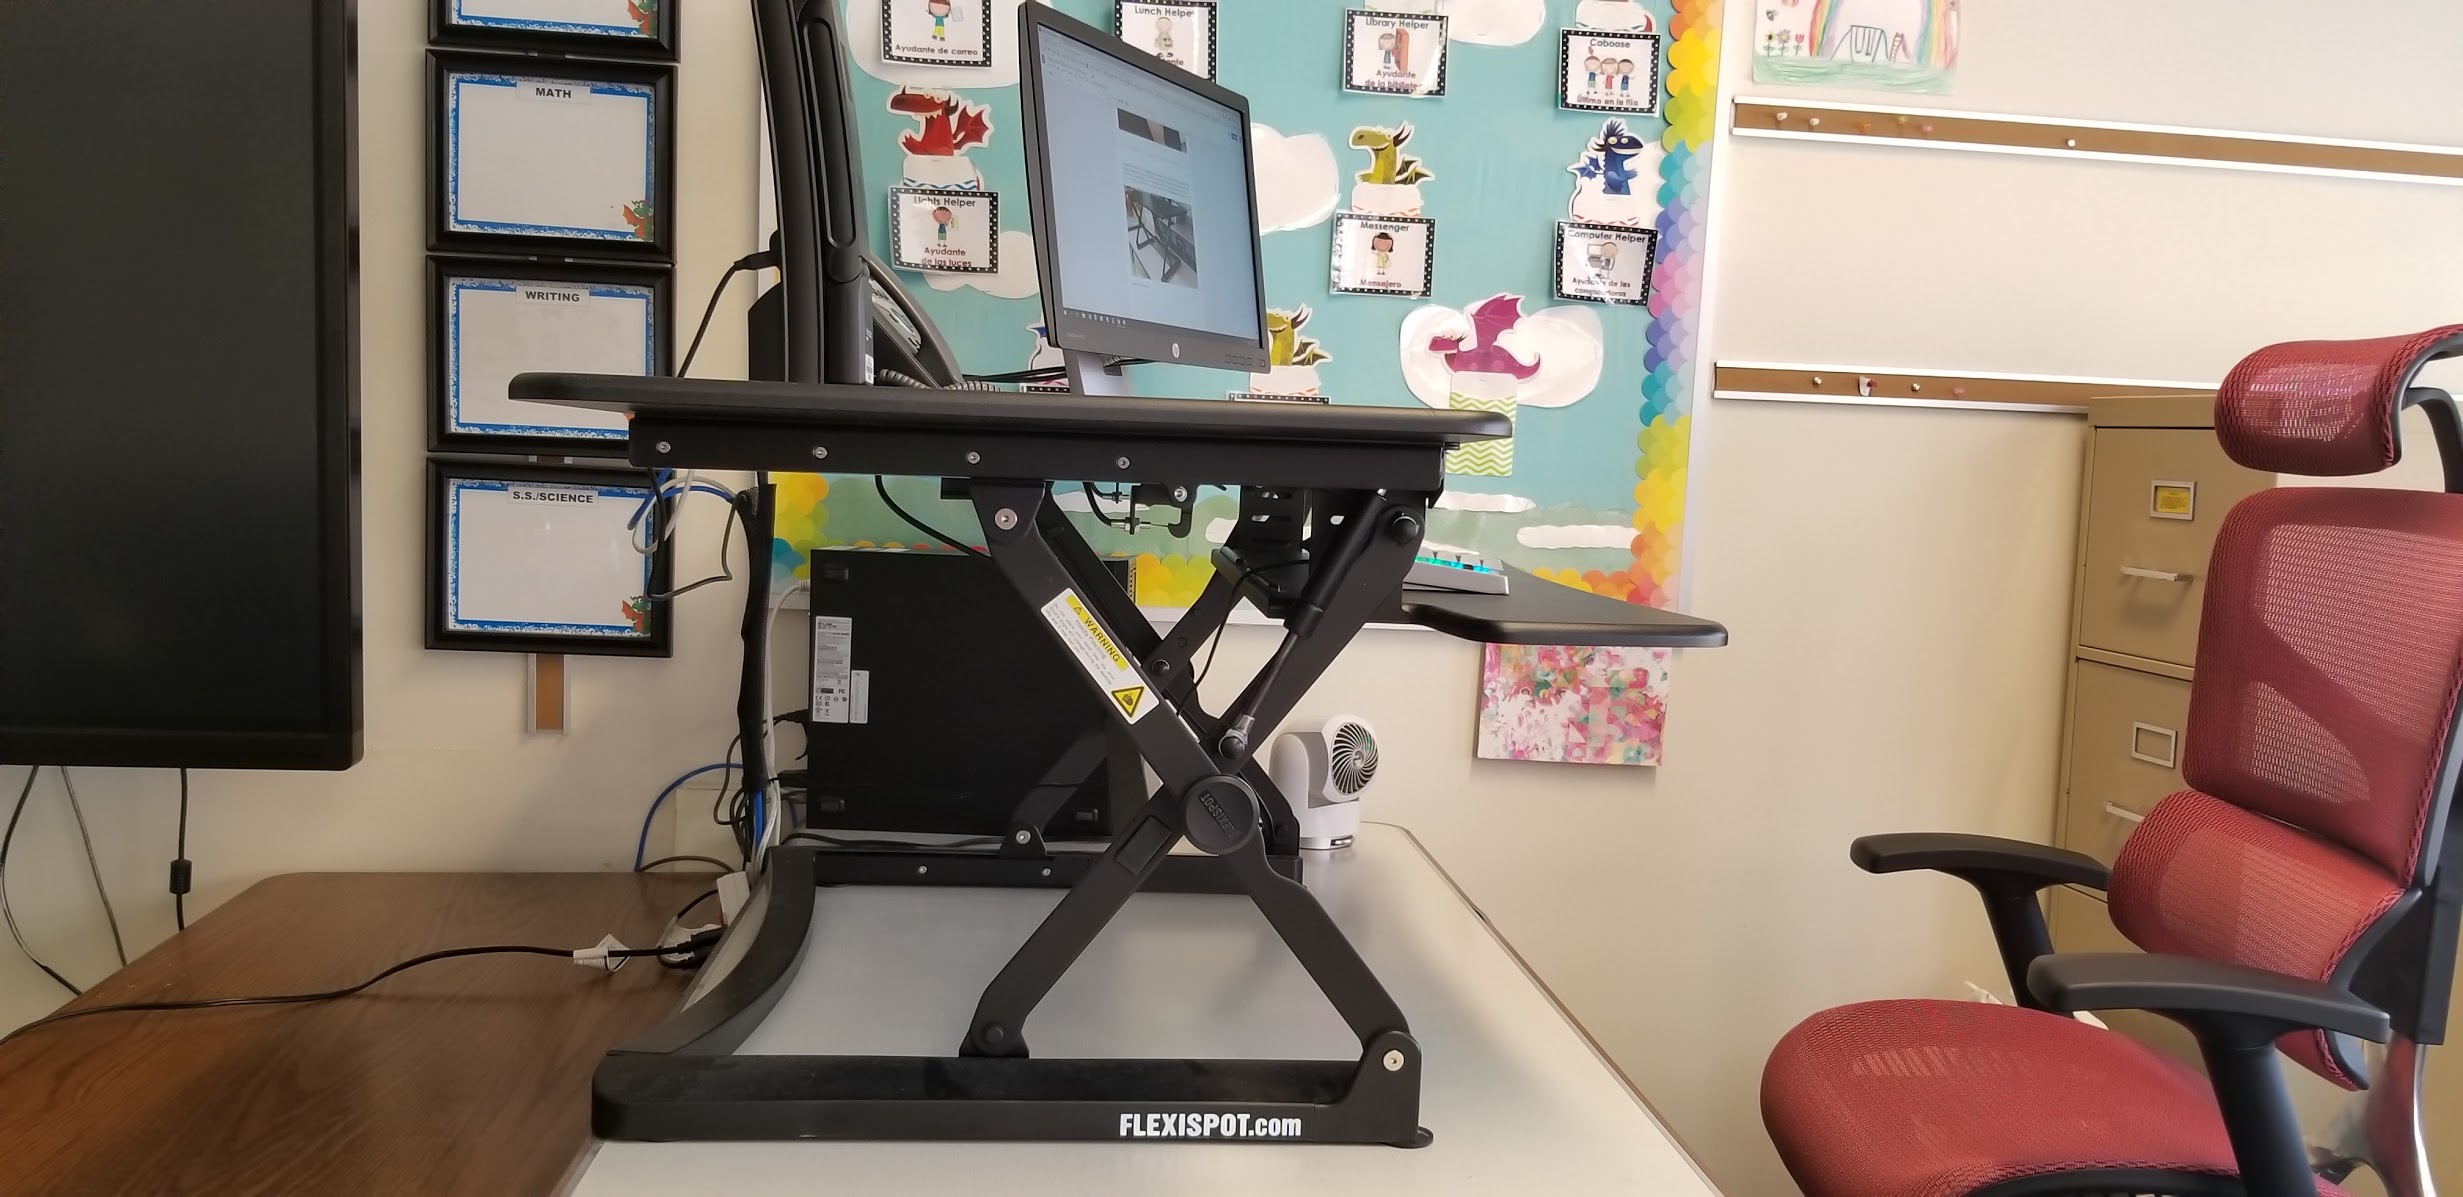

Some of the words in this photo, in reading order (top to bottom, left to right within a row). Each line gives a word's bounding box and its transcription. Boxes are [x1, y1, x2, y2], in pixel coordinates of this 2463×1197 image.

[1134, 5, 1162, 16] Lunch
[1365, 17, 1396, 29] Library
[1398, 19, 1429, 30] Helper
[1589, 38, 1631, 49] Caboose
[895, 44, 936, 54] Ayudante
[937, 47, 949, 55] de
[951, 48, 979, 56] correo
[1376, 69, 1416, 79] Ayudante
[535, 87, 572, 99] MATH
[943, 197, 975, 208] Helper
[1360, 221, 1410, 233] Messenger
[1567, 229, 1613, 240] Computer
[1615, 233, 1647, 244] Helper
[924, 247, 966, 257] Ayudante
[934, 258, 947, 267] las
[948, 259, 972, 268] luces
[525, 291, 581, 303] WRITING
[512, 490, 594, 504] S.S./SCIENCE
[1084, 617, 1120, 662] WARNING
[1200, 793, 1237, 838] LEXISPOT
[1120, 1113, 1302, 1137] FLEXISPOT.com
